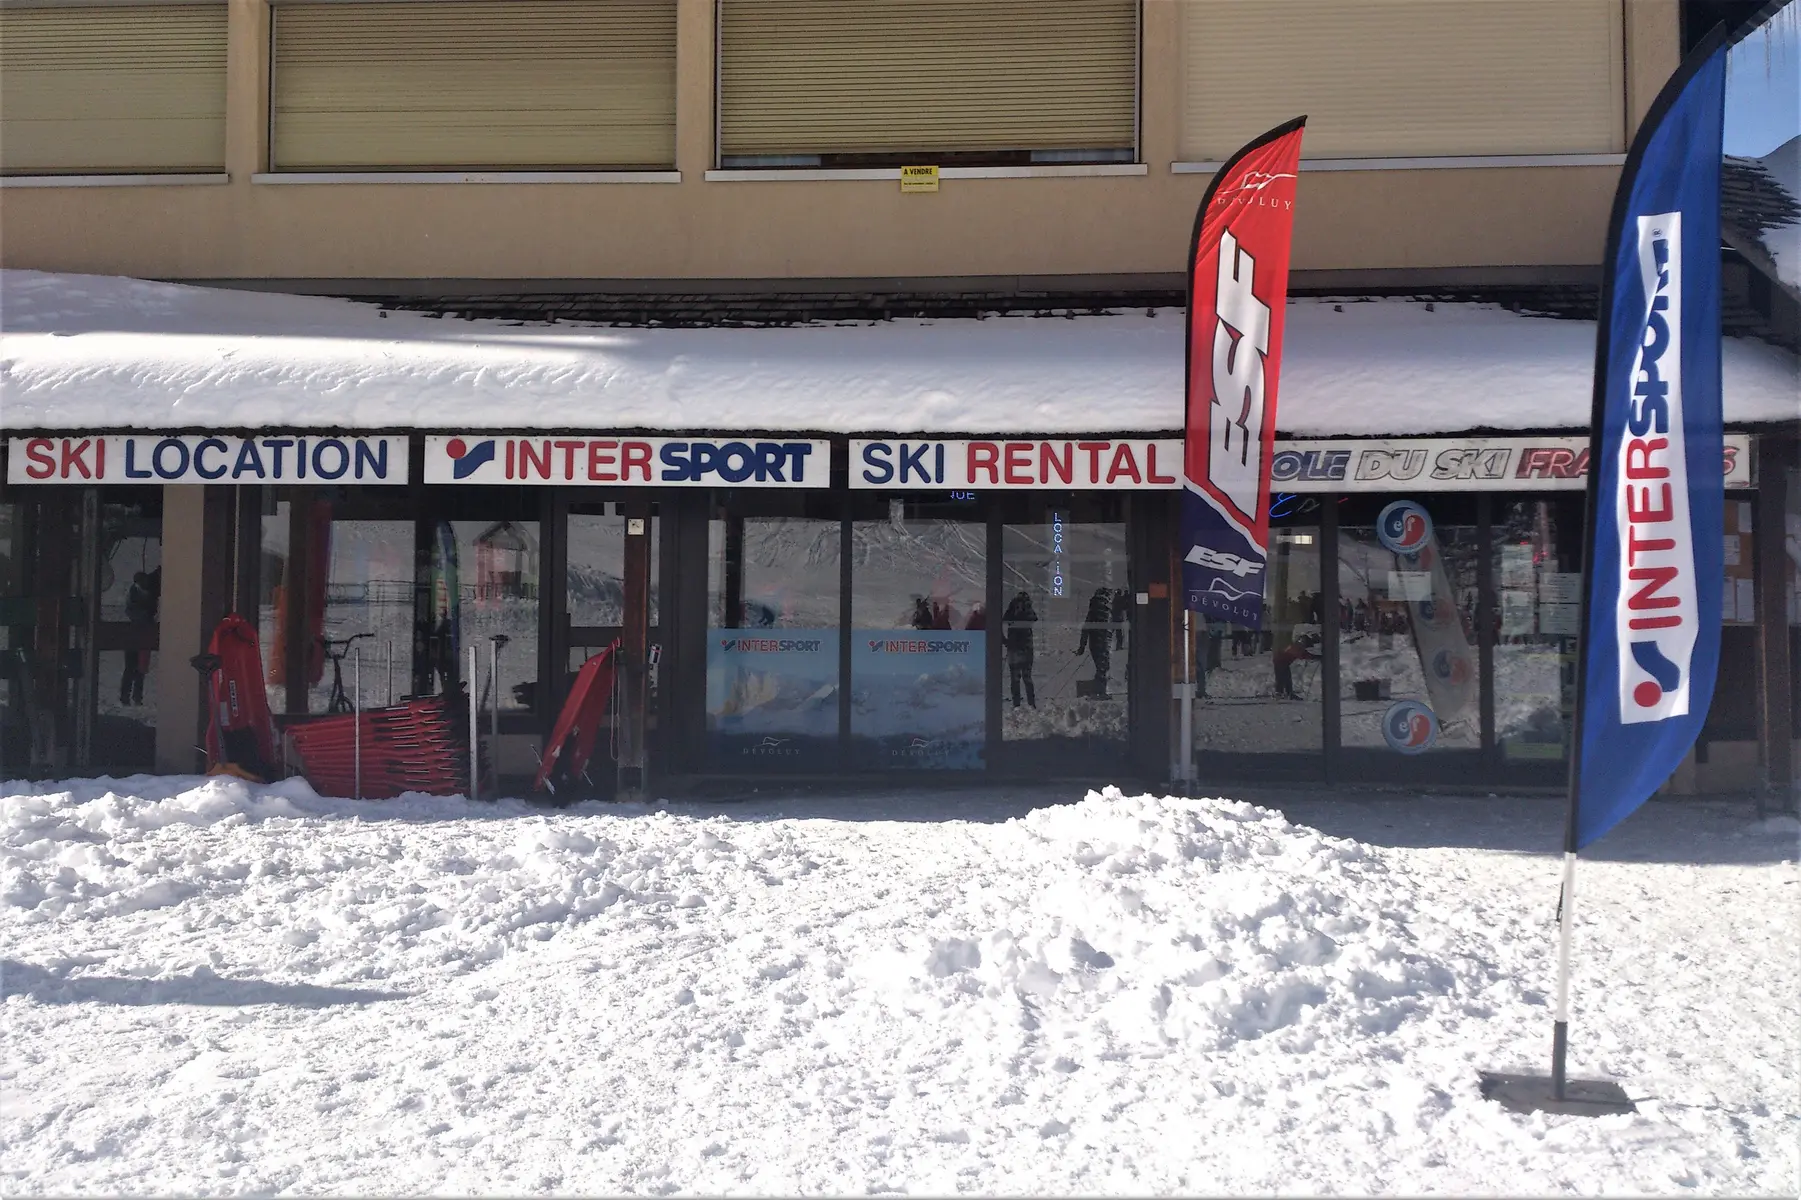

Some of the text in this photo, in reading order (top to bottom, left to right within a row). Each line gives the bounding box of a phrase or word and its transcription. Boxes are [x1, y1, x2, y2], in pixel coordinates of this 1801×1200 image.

[26, 438, 388, 479] SKI LOCATION
[862, 442, 1176, 485] SKI RENTAL
[1354, 449, 1428, 481] DU
[1431, 448, 1512, 480] SKI
[1053, 512, 1063, 596] LOCAION
[1184, 544, 1265, 578] ESF
[737, 639, 821, 652] INTERSPORT
[885, 640, 970, 653] INTERSPORT
